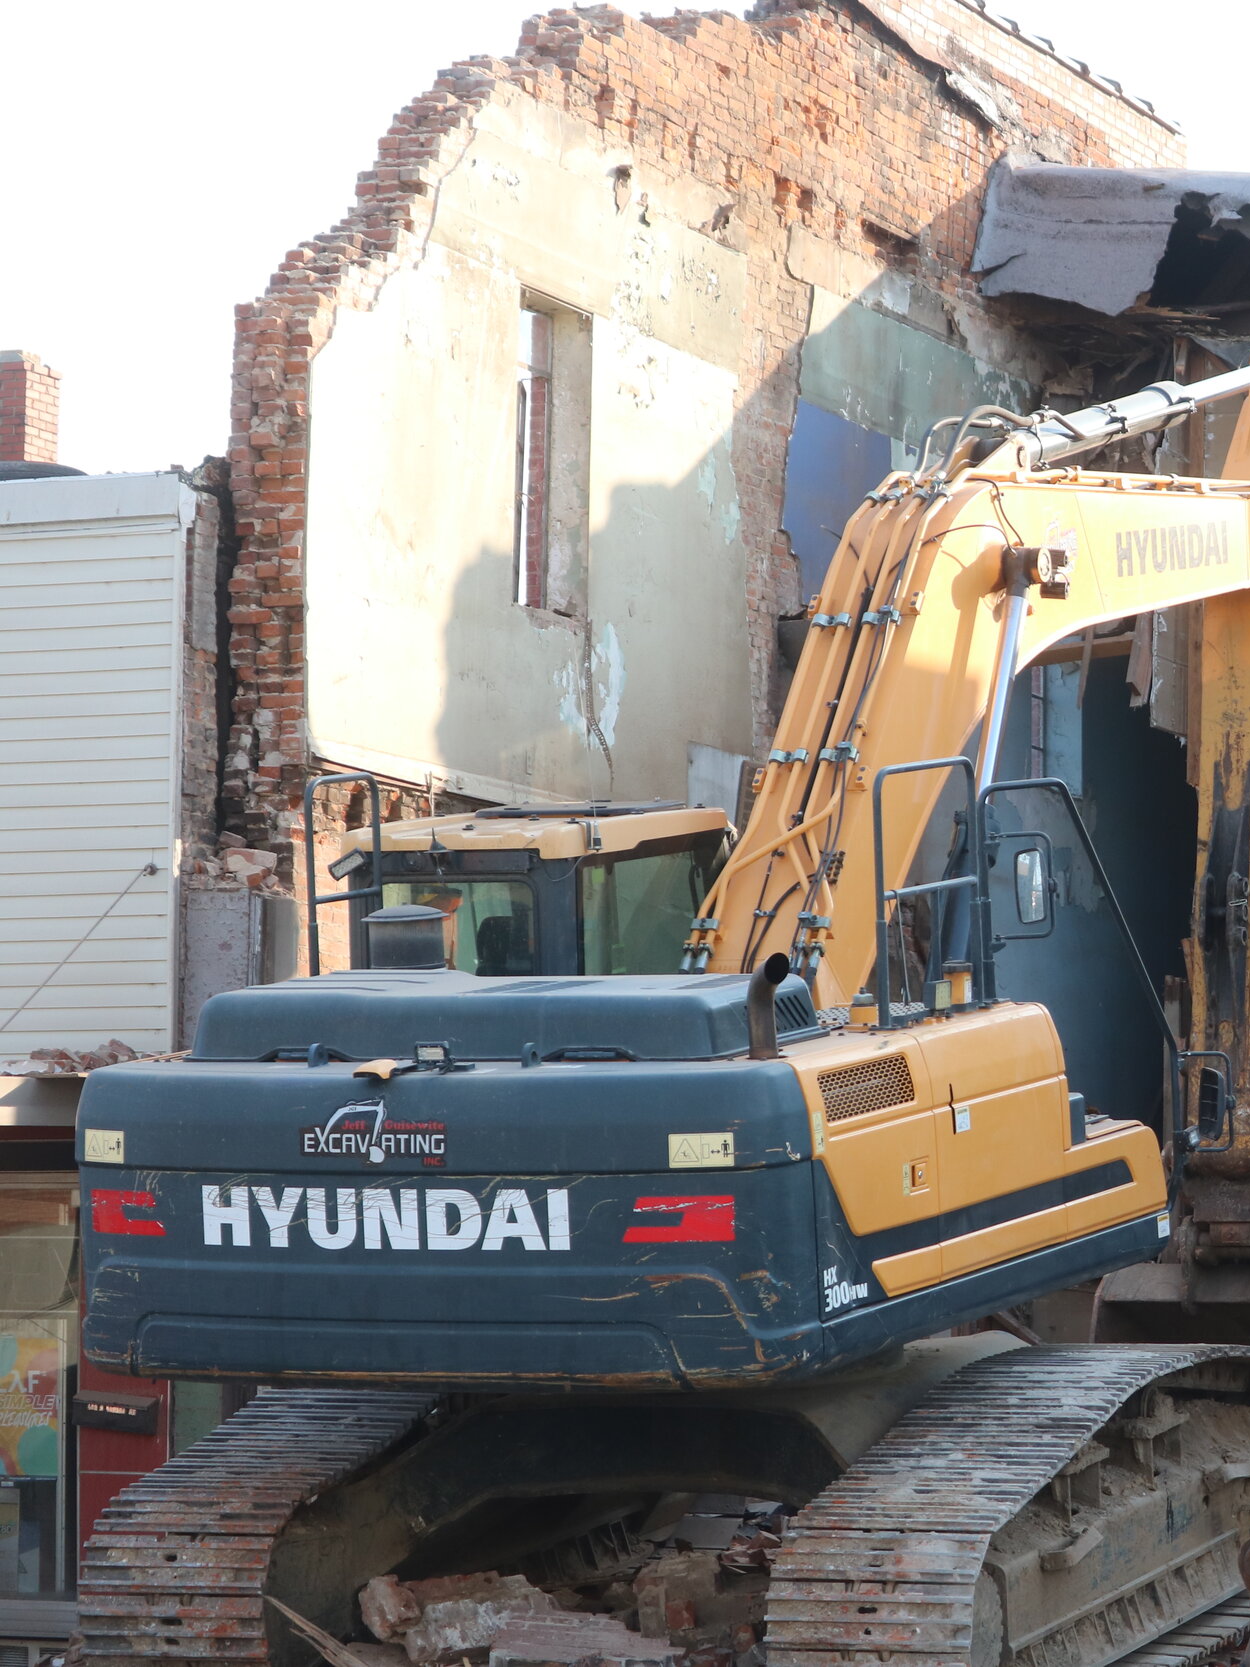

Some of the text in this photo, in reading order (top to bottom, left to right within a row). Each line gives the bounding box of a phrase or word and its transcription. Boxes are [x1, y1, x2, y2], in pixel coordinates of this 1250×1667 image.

[1115, 521, 1229, 577] HYUNDAI
[341, 1120, 445, 1130] Jeff Guisewite
[303, 1127, 445, 1154] EXCAVATING
[423, 1157, 445, 1166] INC.
[201, 1184, 571, 1251] HYUNDAI
[823, 1265, 838, 1287] HX
[824, 1281, 868, 1312] 300HW
